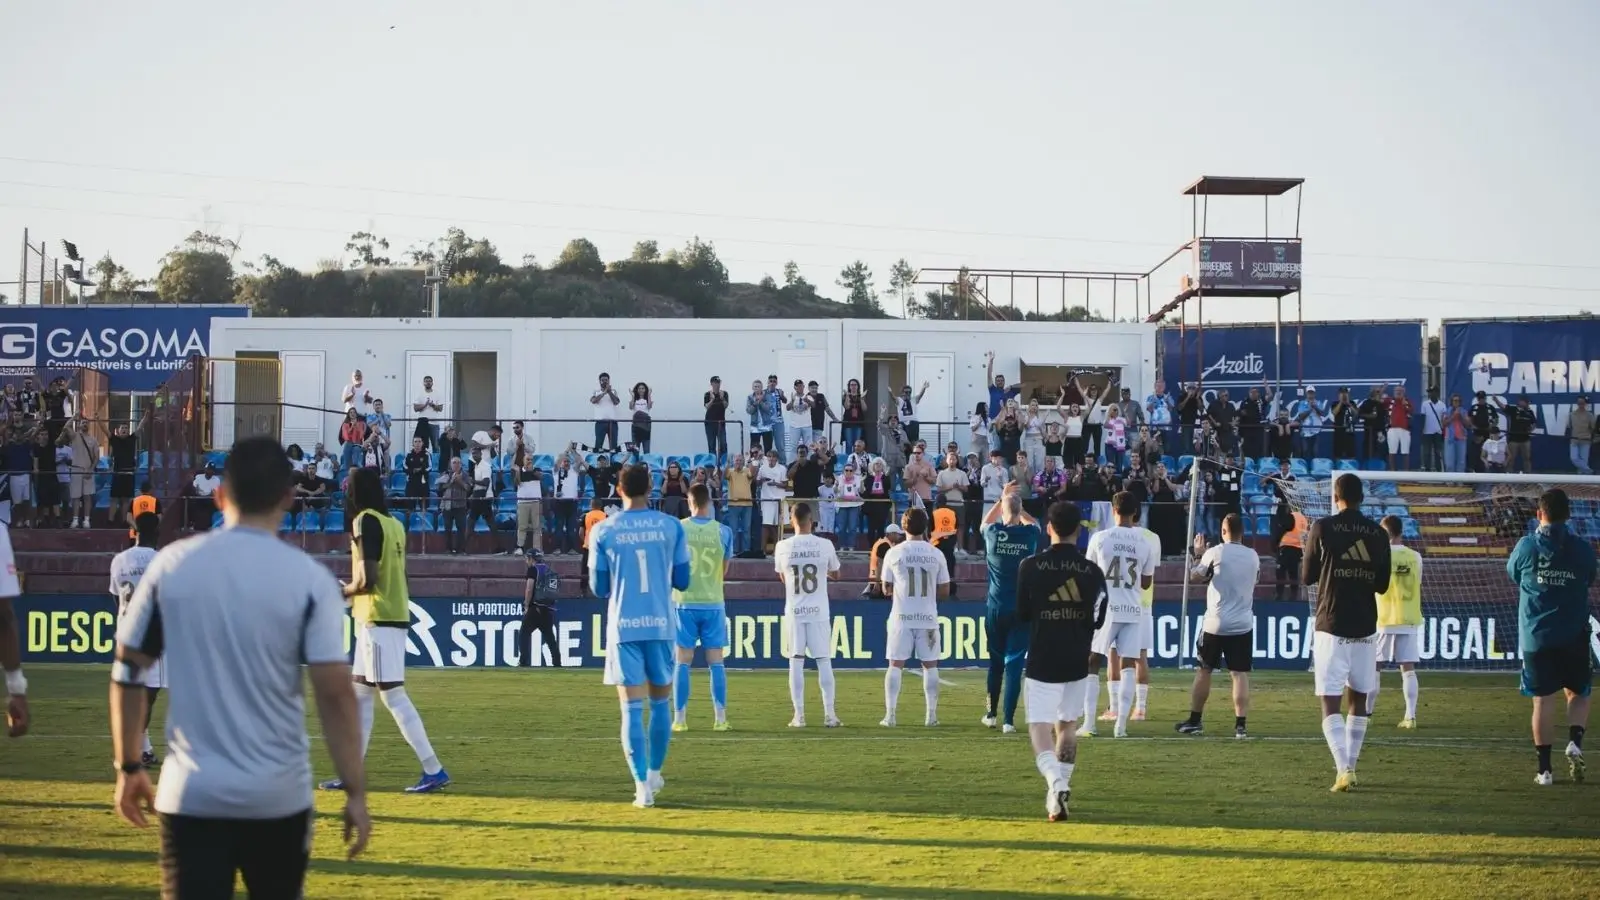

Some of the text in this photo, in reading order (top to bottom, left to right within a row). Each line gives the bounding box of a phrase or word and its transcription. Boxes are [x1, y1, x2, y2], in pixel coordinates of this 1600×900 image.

[134, 362, 142, 370] e
[1201, 353, 1264, 378] Azeite
[615, 530, 666, 545] SEQUEIRA
[996, 542, 1028, 550] HOSPITAL
[635, 549, 649, 593] 1
[791, 563, 818, 595] 18
[907, 567, 928, 597] 11
[1105, 556, 1138, 590] 43
[1537, 569, 1577, 580] HOSPITAL
[452, 602, 523, 616] LIGA PORTUGA
[28, 611, 113, 653] DESC
